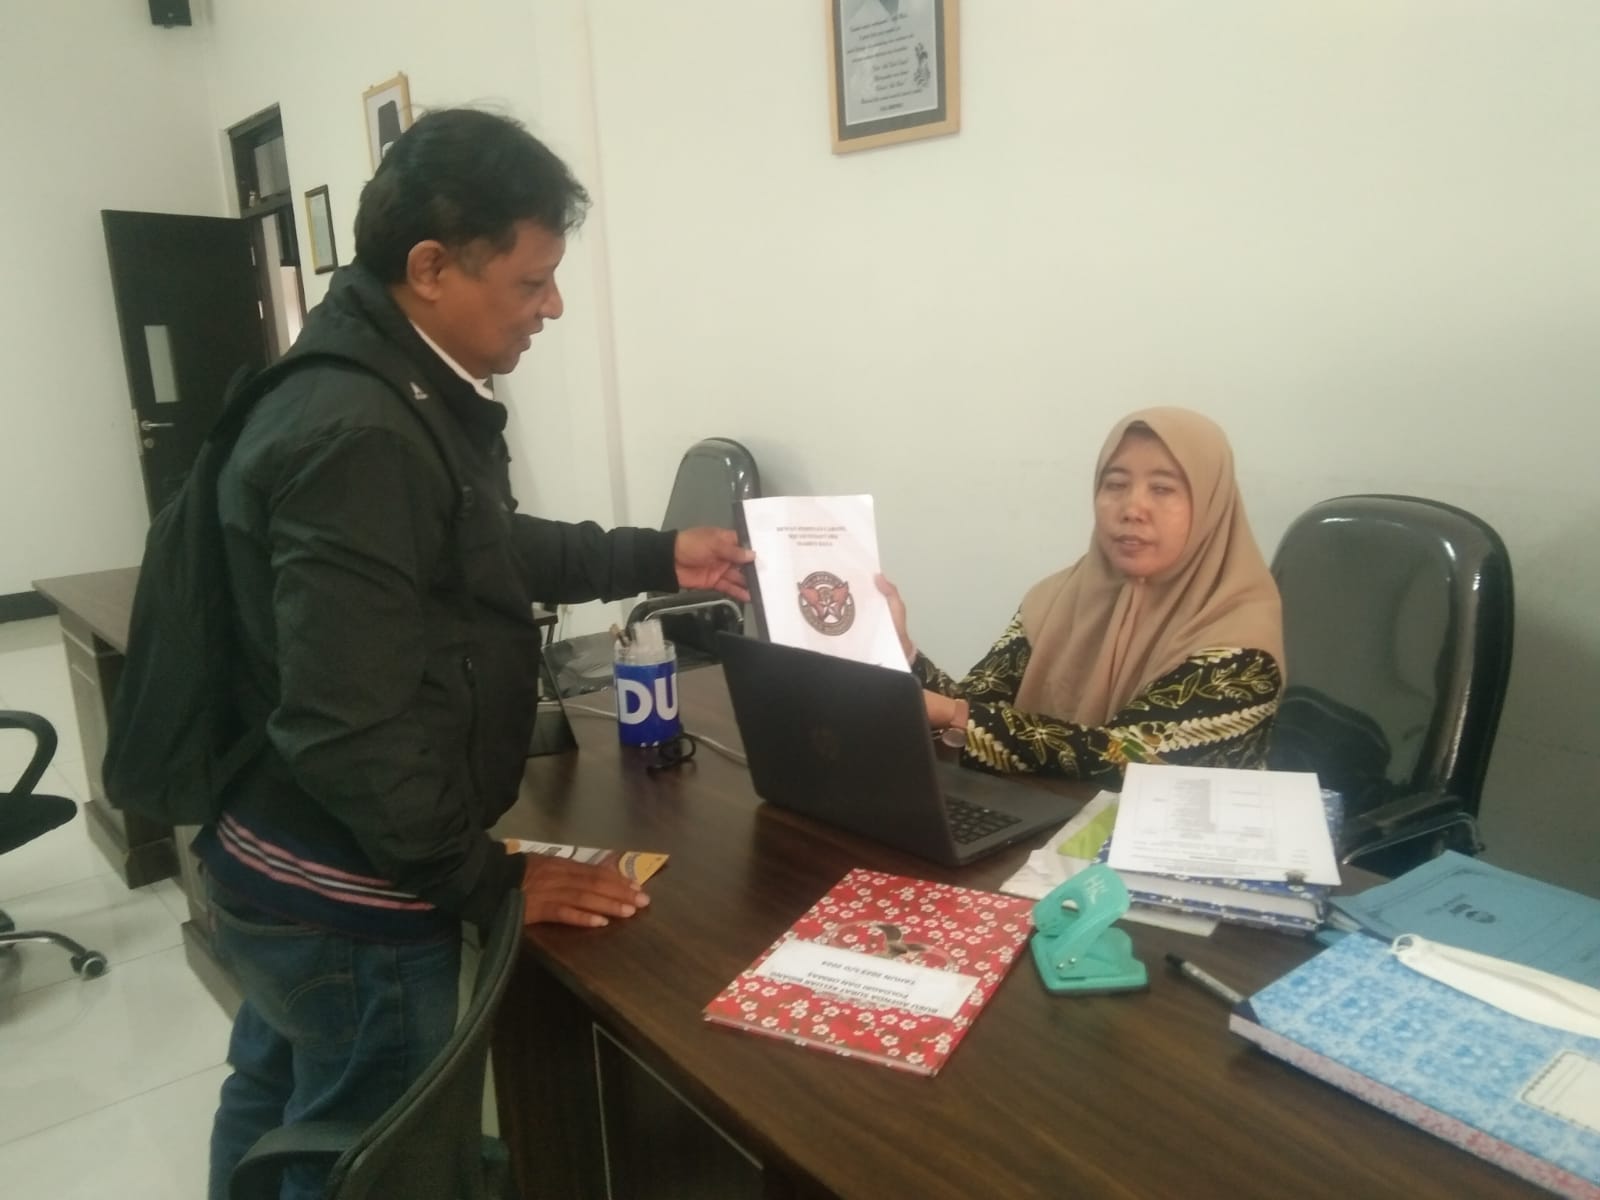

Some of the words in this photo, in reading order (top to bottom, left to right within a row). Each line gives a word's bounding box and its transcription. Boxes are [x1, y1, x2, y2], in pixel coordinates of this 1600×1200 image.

[769, 971, 803, 983] BIDANG
[807, 971, 840, 983] ORMAS
[884, 973, 916, 985] TAHUN
[805, 979, 838, 992] KELUAR
[841, 979, 860, 989] DAN
[840, 987, 869, 998] SURAT
[871, 994, 910, 1007] AGENDA
[911, 1002, 938, 1013] BUKU
